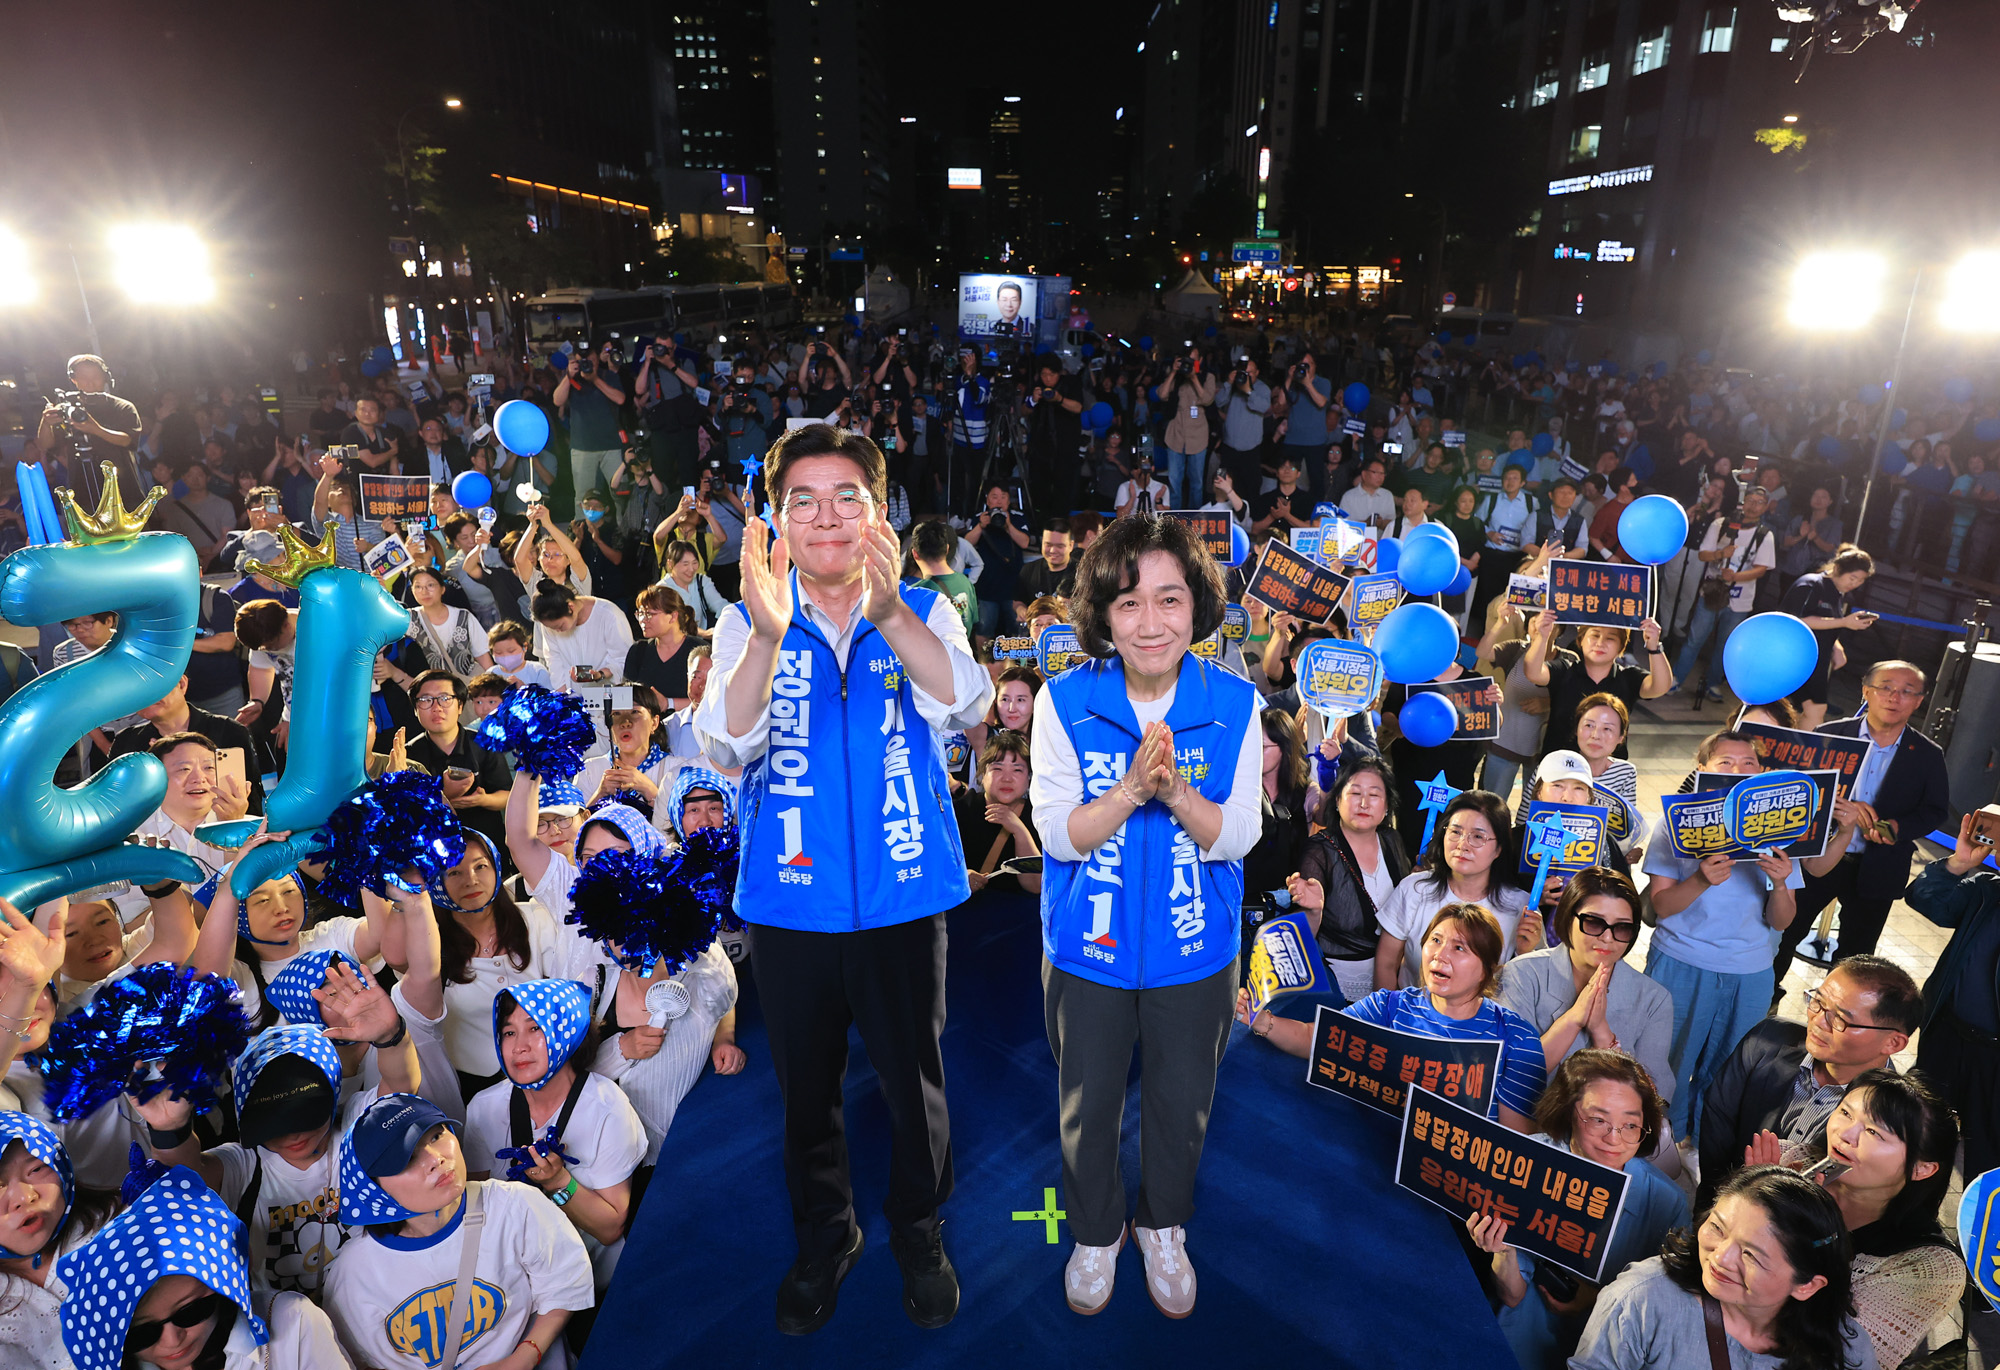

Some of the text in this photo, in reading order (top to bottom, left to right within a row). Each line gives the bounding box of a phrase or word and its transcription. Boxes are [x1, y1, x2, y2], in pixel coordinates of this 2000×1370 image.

[369, 501, 427, 515] 응원하는 서울!
[1209, 541, 1229, 554] 실현!
[1264, 549, 1342, 602] 발달장애인의 내일을
[1555, 567, 1641, 593] 함께 사는 서울
[1259, 574, 1330, 618] 응원하는 서울!
[1360, 588, 1397, 603] 서울시장은
[1554, 592, 1643, 617] 행복한 서울!
[1357, 598, 1397, 619] 정원오
[1000, 639, 1032, 652] 정원오!
[1314, 657, 1371, 676] 서울시장은
[1309, 670, 1369, 696] 정원오
[769, 650, 814, 796] 정원오
[1464, 712, 1490, 731] 강화!
[1753, 735, 1859, 775] 장애인의 내일을
[1744, 792, 1807, 815] 서울시장은
[1083, 751, 1126, 888] 정오
[1678, 811, 1724, 828] 서울시
[1742, 806, 1807, 837] 정원오
[777, 807, 813, 866] 1
[1544, 834, 1562, 849] 정원오
[1678, 824, 1734, 848] 정원
[778, 871, 813, 885] 민주당
[896, 865, 923, 883] 후보
[1169, 808, 1206, 939] 울시장
[1083, 891, 1117, 948] 1
[1083, 946, 1115, 964] 민주당
[1180, 940, 1204, 956] 후보
[1262, 931, 1299, 987] 서울시장은
[1326, 1024, 1485, 1099] 최중증 발달장애
[273, 1091, 288, 1100] joys
[1413, 1107, 1610, 1219] 발달장애인의 내일을
[1419, 1155, 1597, 1259] 응원하는 서울!
